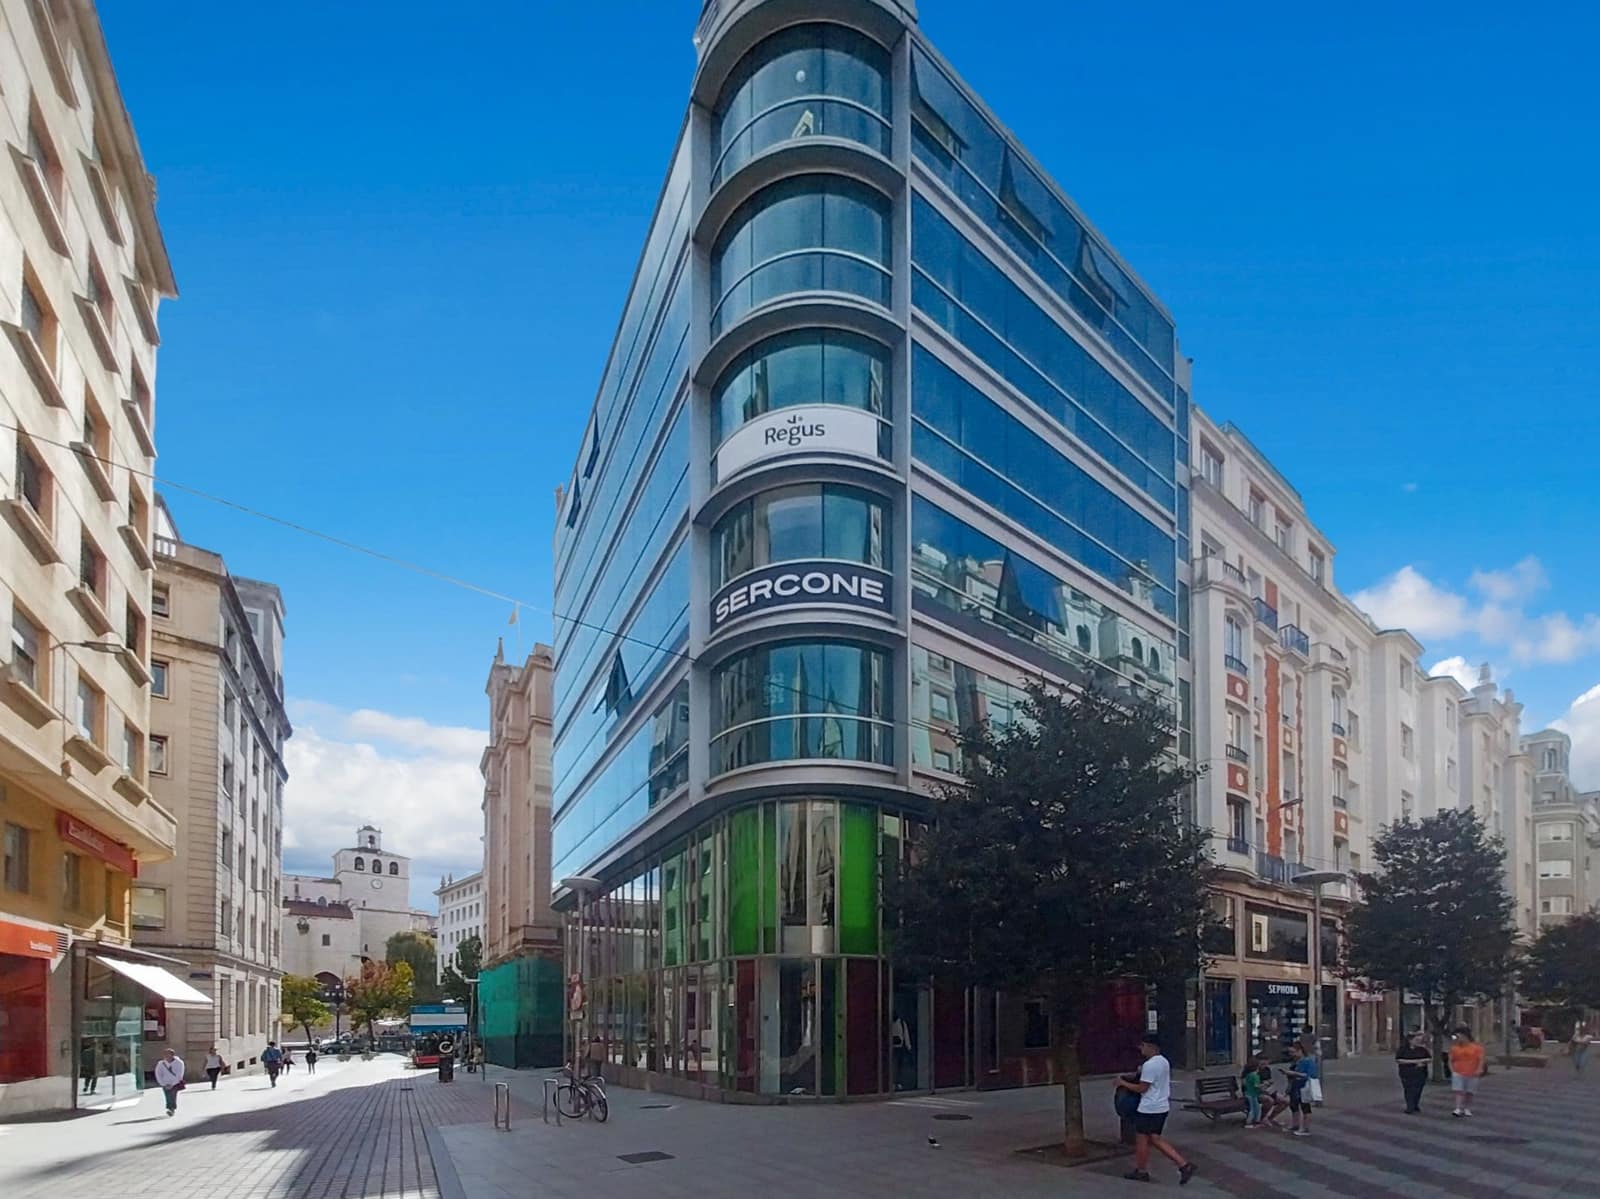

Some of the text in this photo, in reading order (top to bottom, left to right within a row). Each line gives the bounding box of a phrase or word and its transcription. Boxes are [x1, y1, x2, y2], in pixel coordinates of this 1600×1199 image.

[764, 423, 825, 445] Regus
[715, 572, 884, 623] SERCONE
[1268, 984, 1299, 995] SEPHORA
